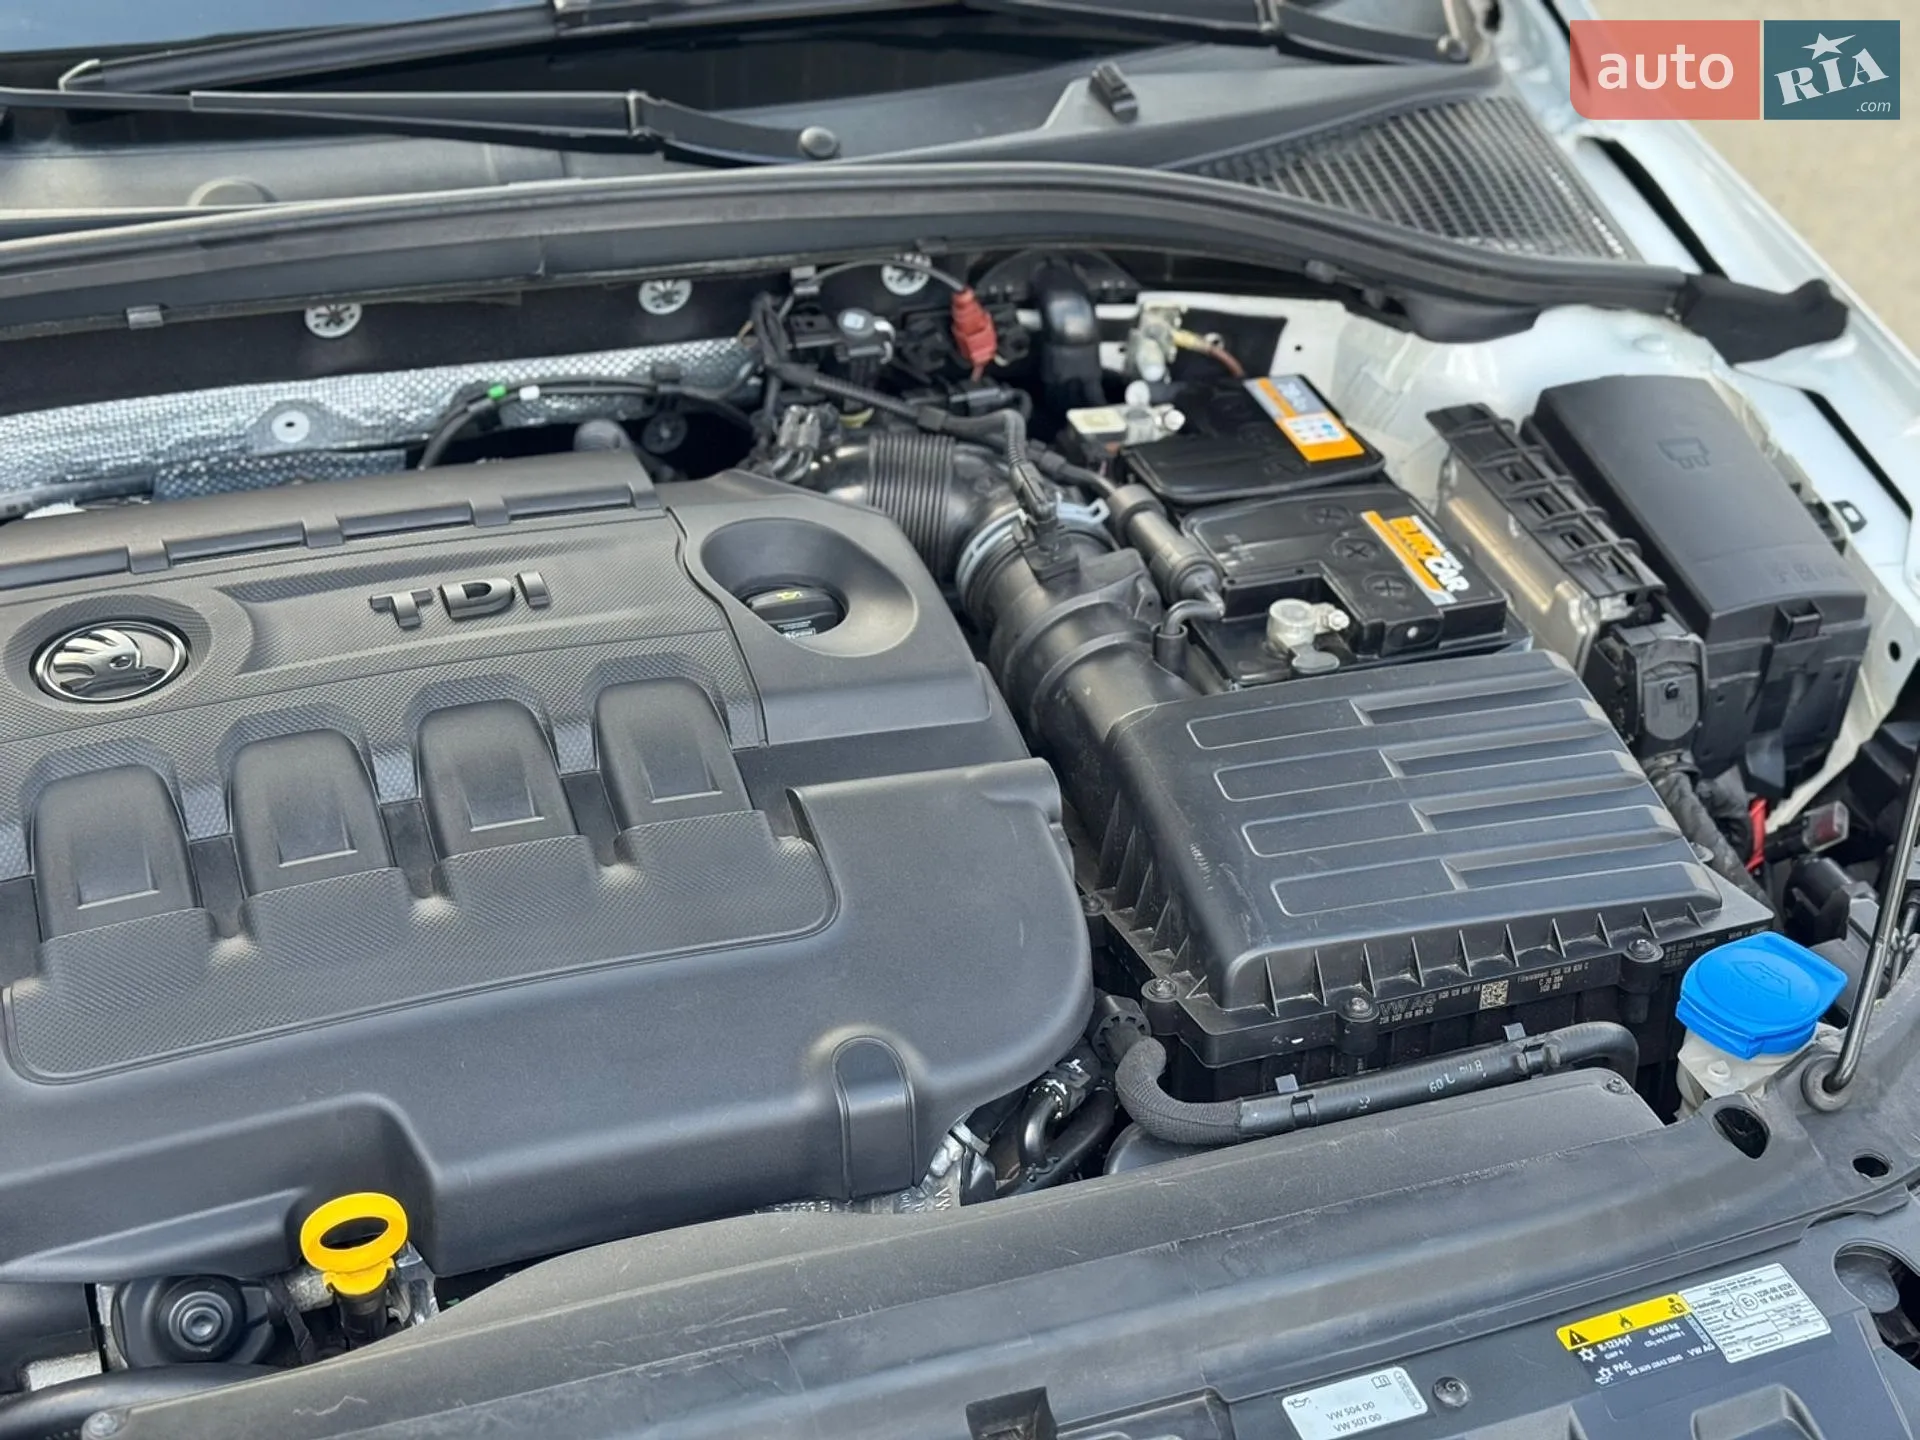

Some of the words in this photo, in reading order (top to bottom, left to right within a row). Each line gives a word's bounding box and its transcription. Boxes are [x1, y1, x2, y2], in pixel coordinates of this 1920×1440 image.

[369, 571, 551, 628] TDI
[1612, 1360, 1633, 1373] PAG
[1326, 1409, 1343, 1421] VW
[1344, 1405, 1362, 1417] 504
[1362, 1400, 1376, 1411] 00
[1332, 1421, 1351, 1432] VW
[1351, 1416, 1368, 1428] 507
[1368, 1412, 1382, 1423] 00
